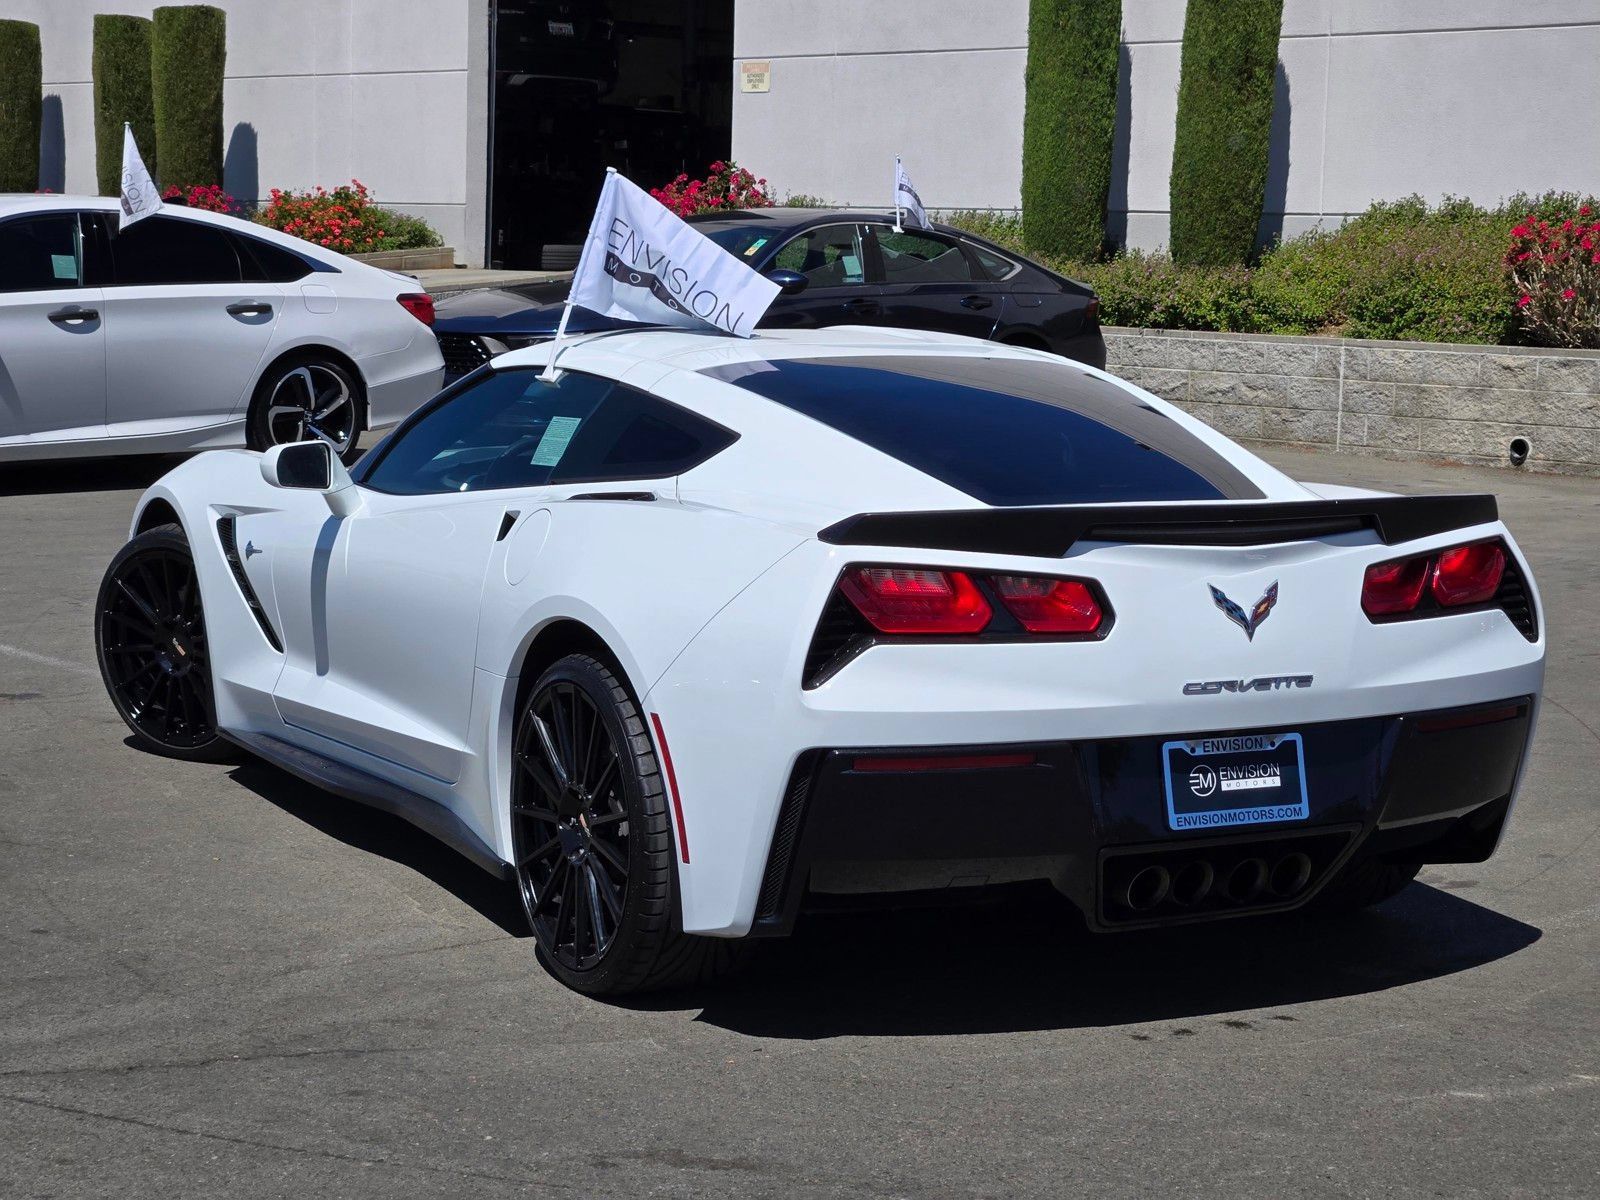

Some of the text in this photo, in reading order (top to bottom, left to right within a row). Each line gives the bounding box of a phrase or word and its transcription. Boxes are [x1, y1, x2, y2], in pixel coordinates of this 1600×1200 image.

[608, 217, 744, 333] ENVISION
[1183, 675, 1314, 695] CORVETTE
[1202, 737, 1264, 753] ENVISION
[1219, 763, 1281, 780] ENVISION
[1226, 779, 1276, 788] MOTORS
[1176, 806, 1303, 828] ENVISIONMOTORS.COM
